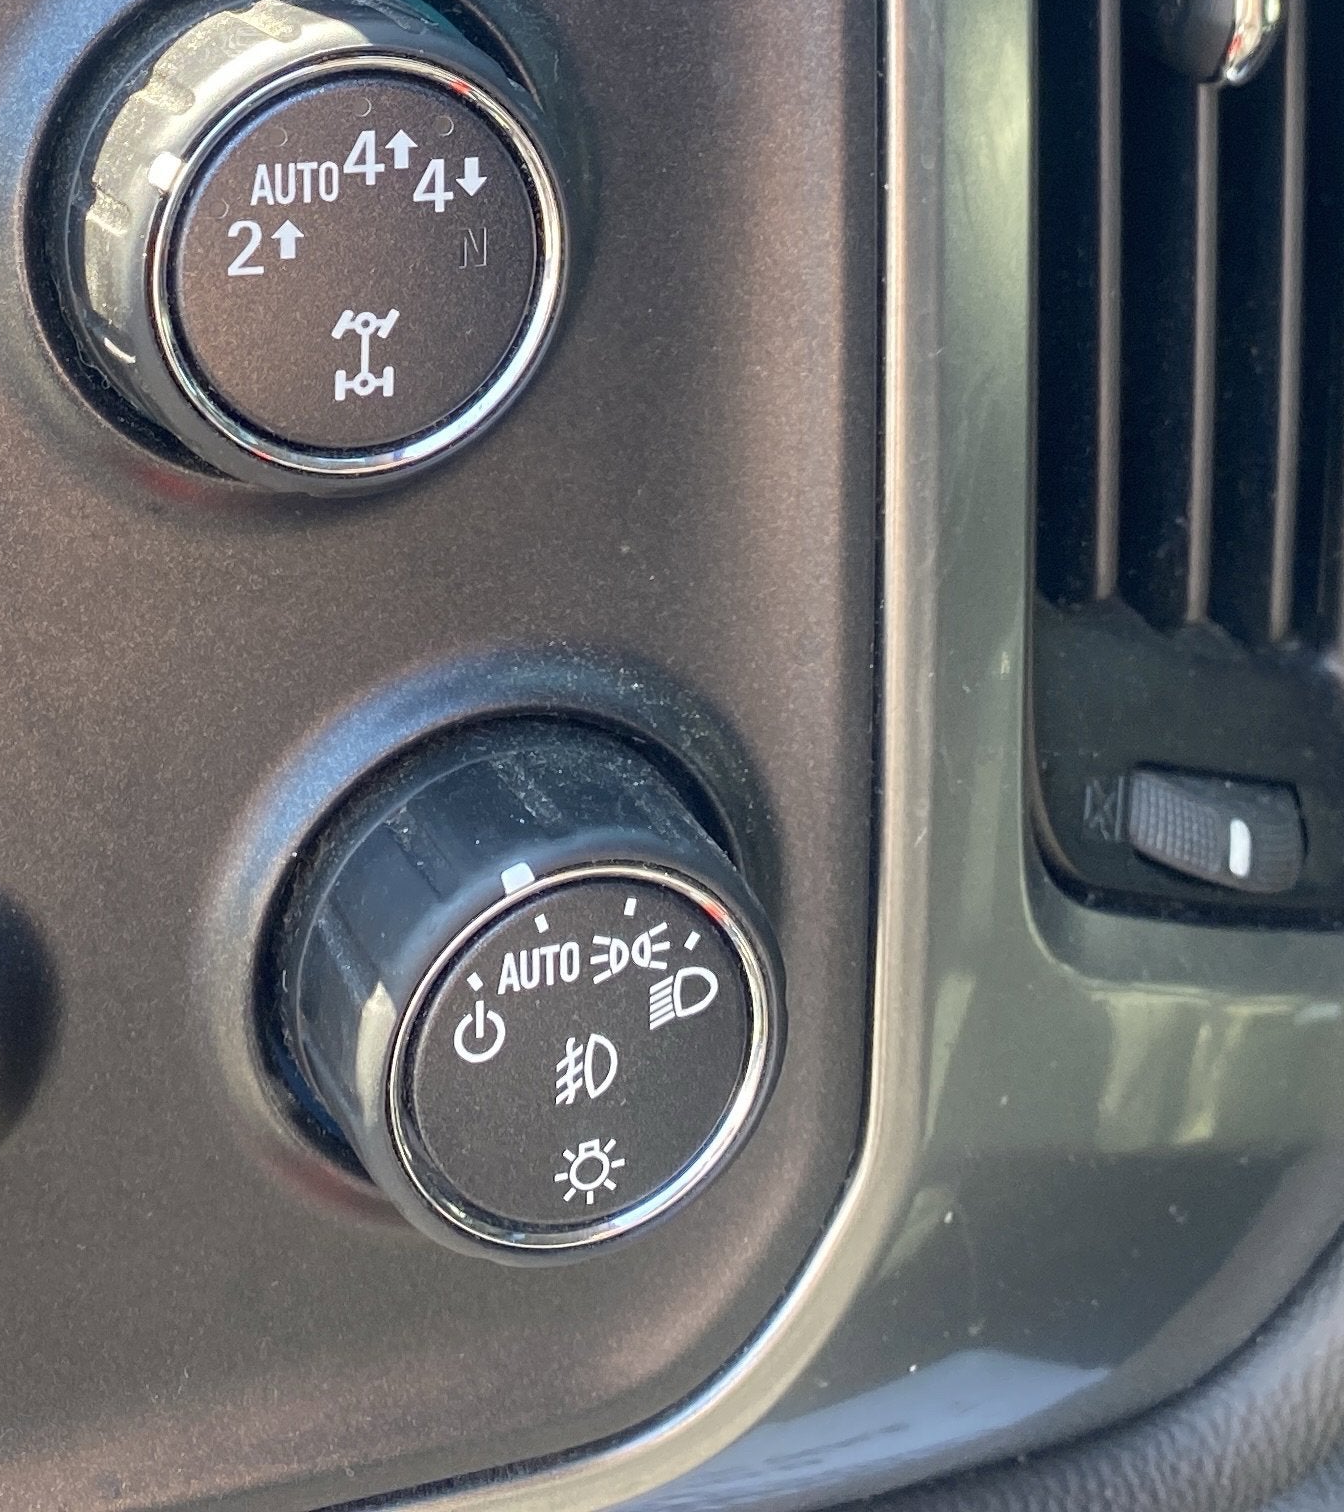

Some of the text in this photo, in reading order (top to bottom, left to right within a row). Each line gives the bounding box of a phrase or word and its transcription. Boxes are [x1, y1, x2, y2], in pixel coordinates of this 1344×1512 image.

[250, 161, 339, 206] AUTO
[343, 130, 385, 186] 4
[413, 158, 454, 213] 4
[227, 220, 265, 276] 2
[497, 941, 580, 996] AUTO
